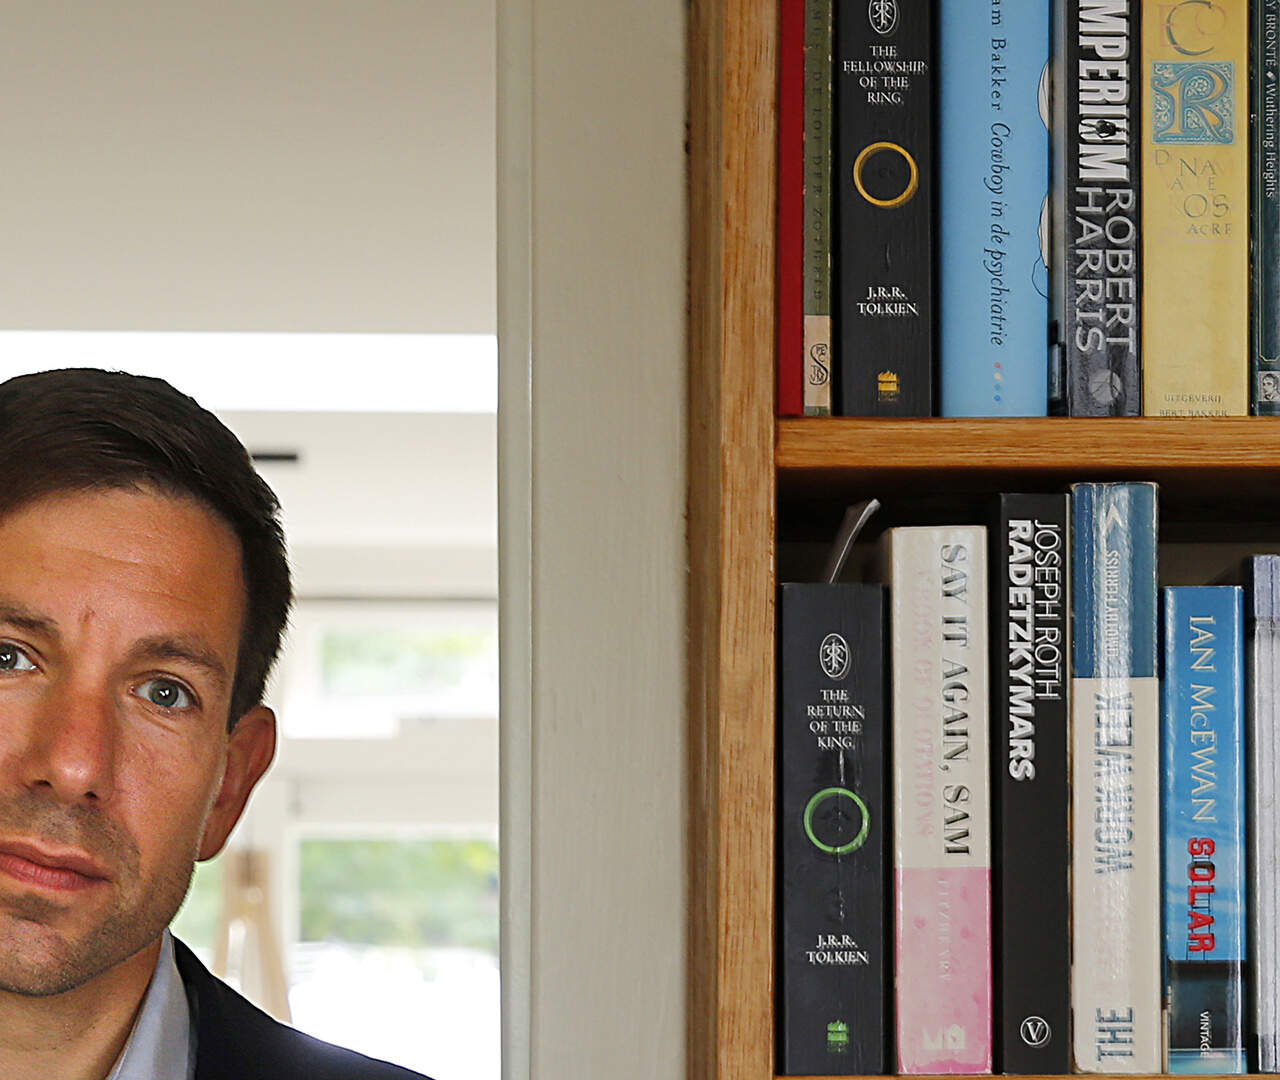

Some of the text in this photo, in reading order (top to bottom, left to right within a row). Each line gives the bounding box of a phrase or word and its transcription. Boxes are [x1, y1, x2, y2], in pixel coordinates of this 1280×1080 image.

[843, 61, 928, 72] FELLOWSHIP
[869, 46, 897, 56] THE
[859, 76, 910, 87] OF THE
[867, 92, 902, 102] RING
[1263, 83, 1278, 199] Wuthering Heights
[984, 39, 1010, 345] Bakker Cowboy in de psychiatrie
[867, 287, 909, 298] J.R.R.
[1075, 186, 1103, 352] HARRIS
[1104, 188, 1137, 353] ROBERT
[857, 303, 919, 316] TOLKIEN
[941, 544, 969, 603] SAY
[942, 616, 968, 646] IT
[1034, 520, 1061, 699] JOSEPH ROTH
[1008, 520, 1035, 780] RADETZKYMARS
[1190, 616, 1215, 672] IAN
[943, 785, 970, 856] SAM
[1187, 838, 1215, 953] SOLAR
